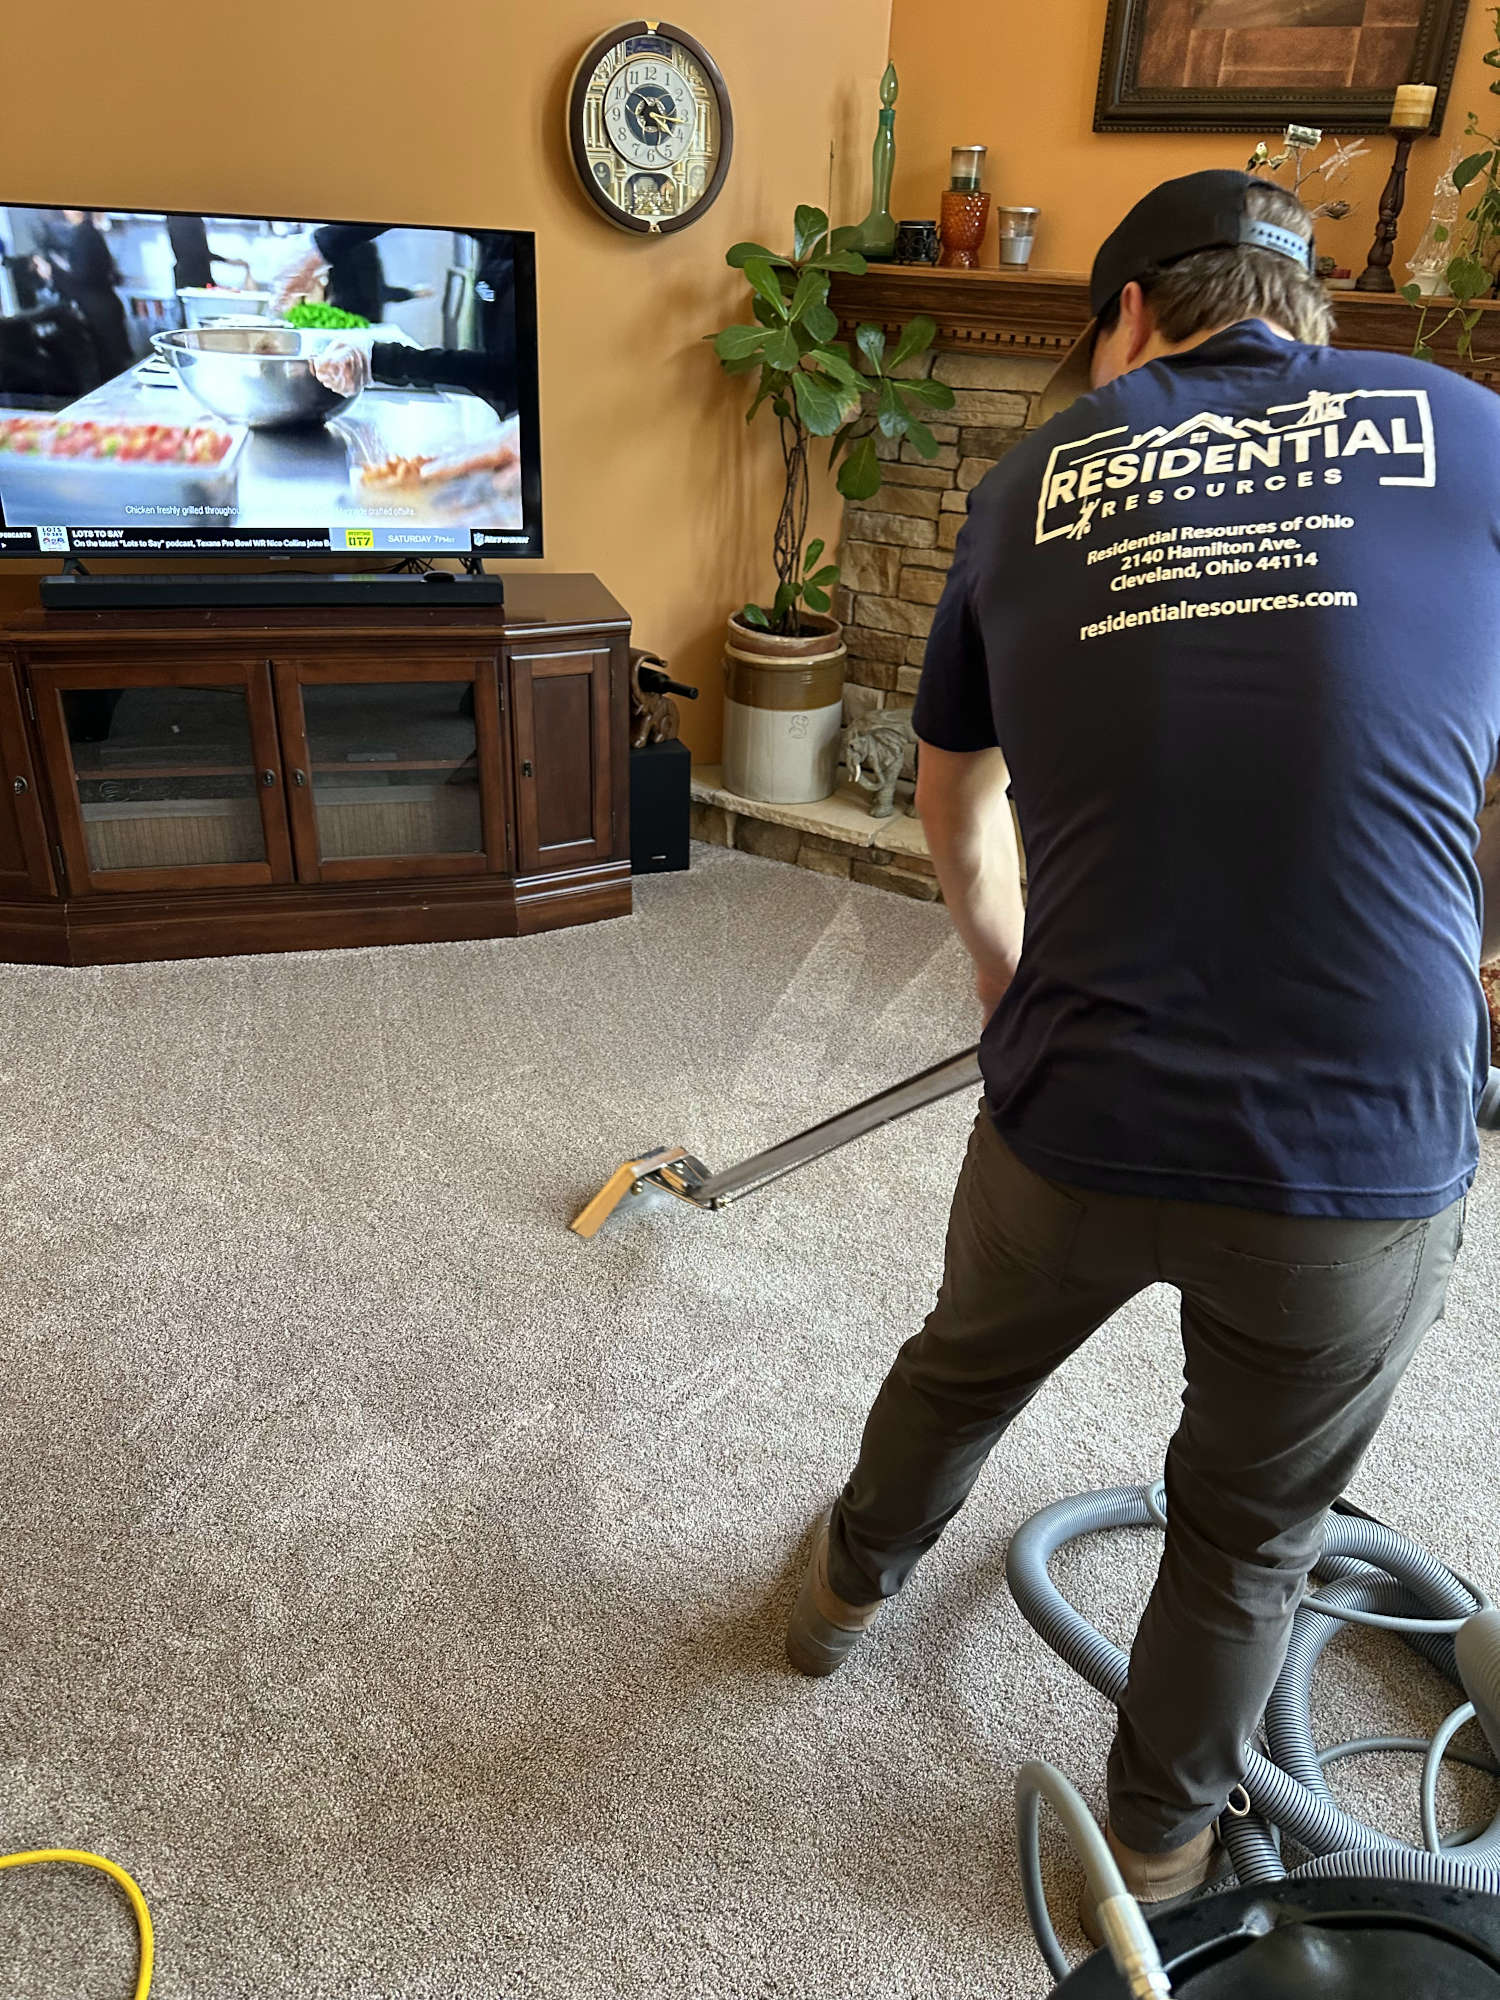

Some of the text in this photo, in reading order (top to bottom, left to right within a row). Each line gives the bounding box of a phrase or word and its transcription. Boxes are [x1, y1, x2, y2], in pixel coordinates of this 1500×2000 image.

[629, 71, 639, 85] 11
[644, 66, 657, 80] 12
[664, 72, 671, 86] 1
[615, 86, 627, 99] 10
[675, 88, 684, 101] 2
[612, 108, 621, 121] 9
[618, 127, 627, 141] 8
[675, 129, 684, 143] 4
[631, 144, 639, 157] 7
[646, 150, 655, 162] 6
[664, 144, 672, 158] 5
[1047, 418, 1424, 510] RESIDENTIAL
[1101, 468, 1344, 519] RESOURCES
[125, 505, 155, 515] Chicken
[156, 504, 180, 516] freshly
[182, 504, 204, 516] grilled
[71, 530, 124, 538] LOTS TO SAY
[387, 534, 432, 543] SATURDAY
[1087, 514, 1355, 566] Residential Resources of Ohio
[73, 540, 85, 548] On
[85, 540, 98, 548] the
[98, 540, 118, 548] latest
[138, 540, 148, 548] to
[165, 540, 196, 549] podcast,
[196, 539, 221, 548] Texans
[222, 539, 234, 547] Pro
[234, 539, 252, 548] Bowl
[252, 539, 266, 547] WR
[266, 539, 282, 548] Nico
[283, 539, 306, 548] Collins
[307, 539, 323, 549] joins
[1120, 537, 1303, 571] 2140 Hamilton Ave.
[1110, 551, 1319, 592] Cleveland, Ohio 44114
[1080, 591, 1358, 641] residentialresources.com
